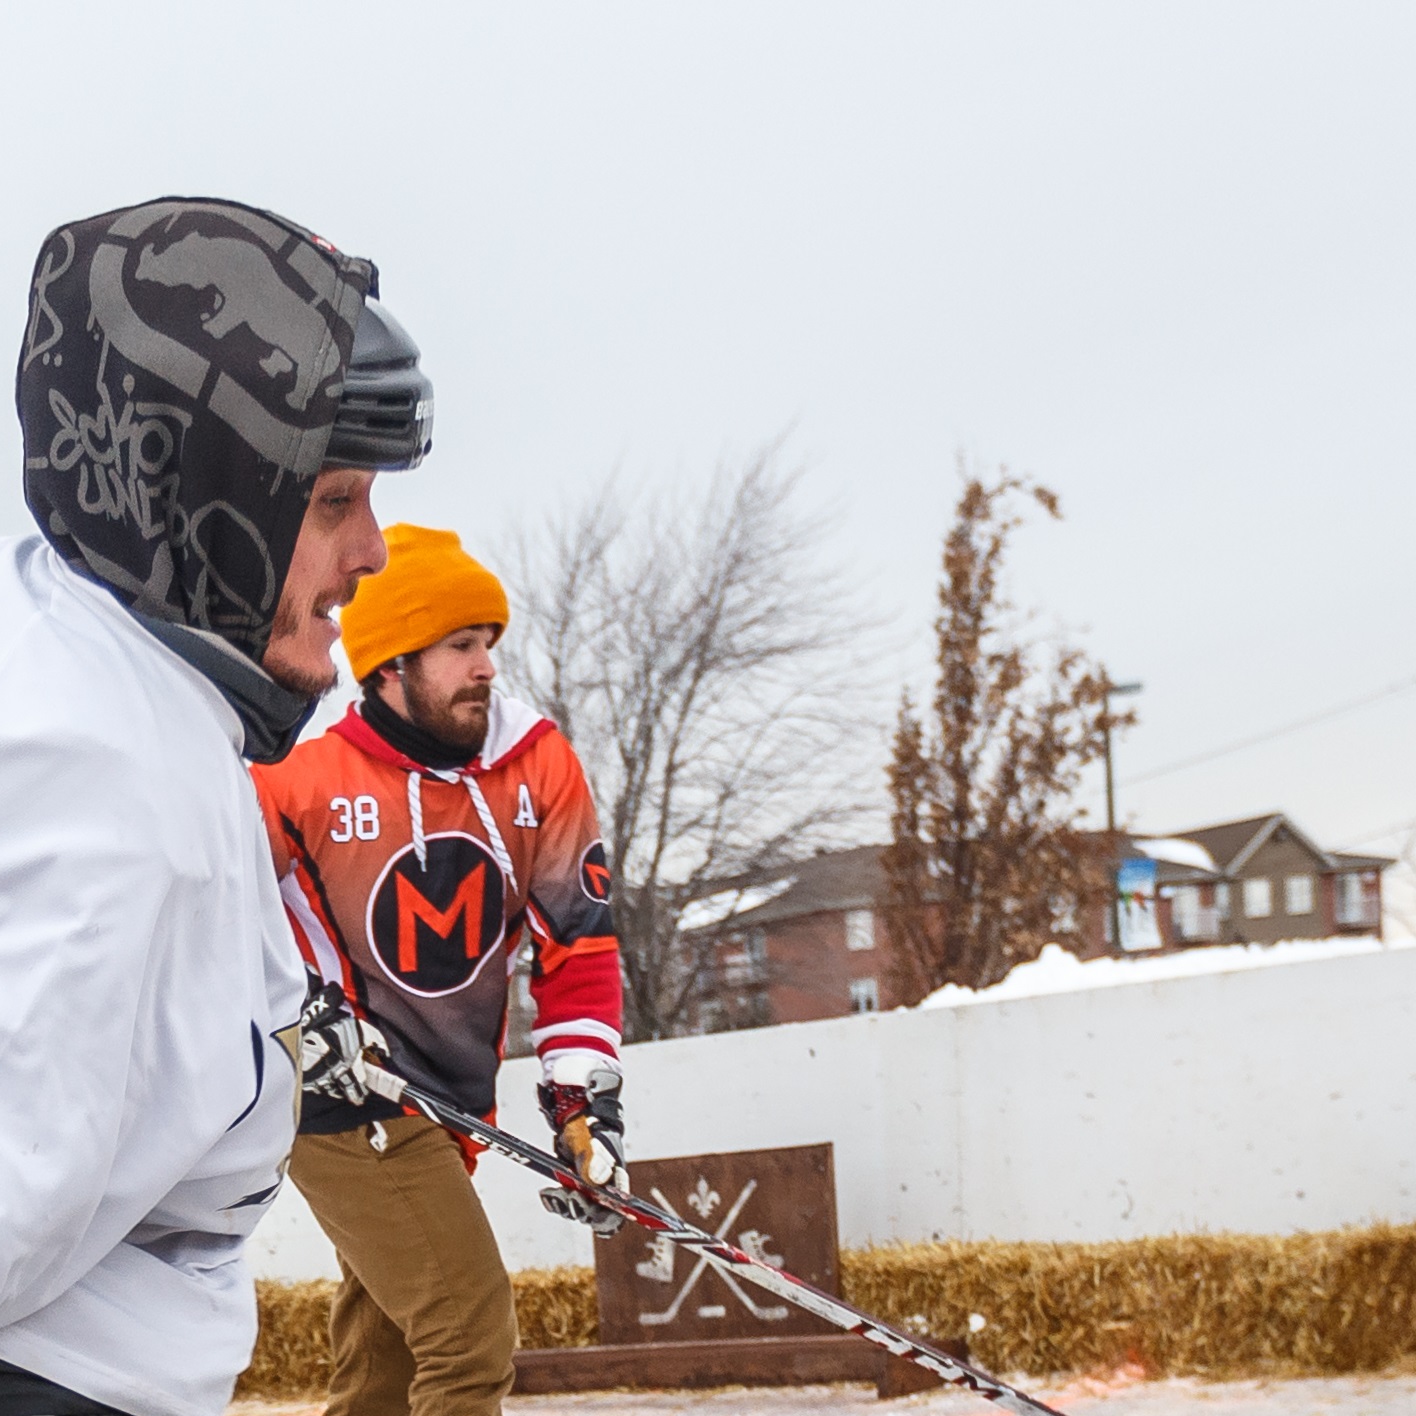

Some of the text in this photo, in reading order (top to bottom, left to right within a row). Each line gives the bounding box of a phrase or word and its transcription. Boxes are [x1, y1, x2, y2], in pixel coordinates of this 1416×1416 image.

[330, 795, 380, 843] 38
[513, 784, 539, 828] A
[395, 860, 486, 973] M
[469, 1131, 531, 1165] CCM
